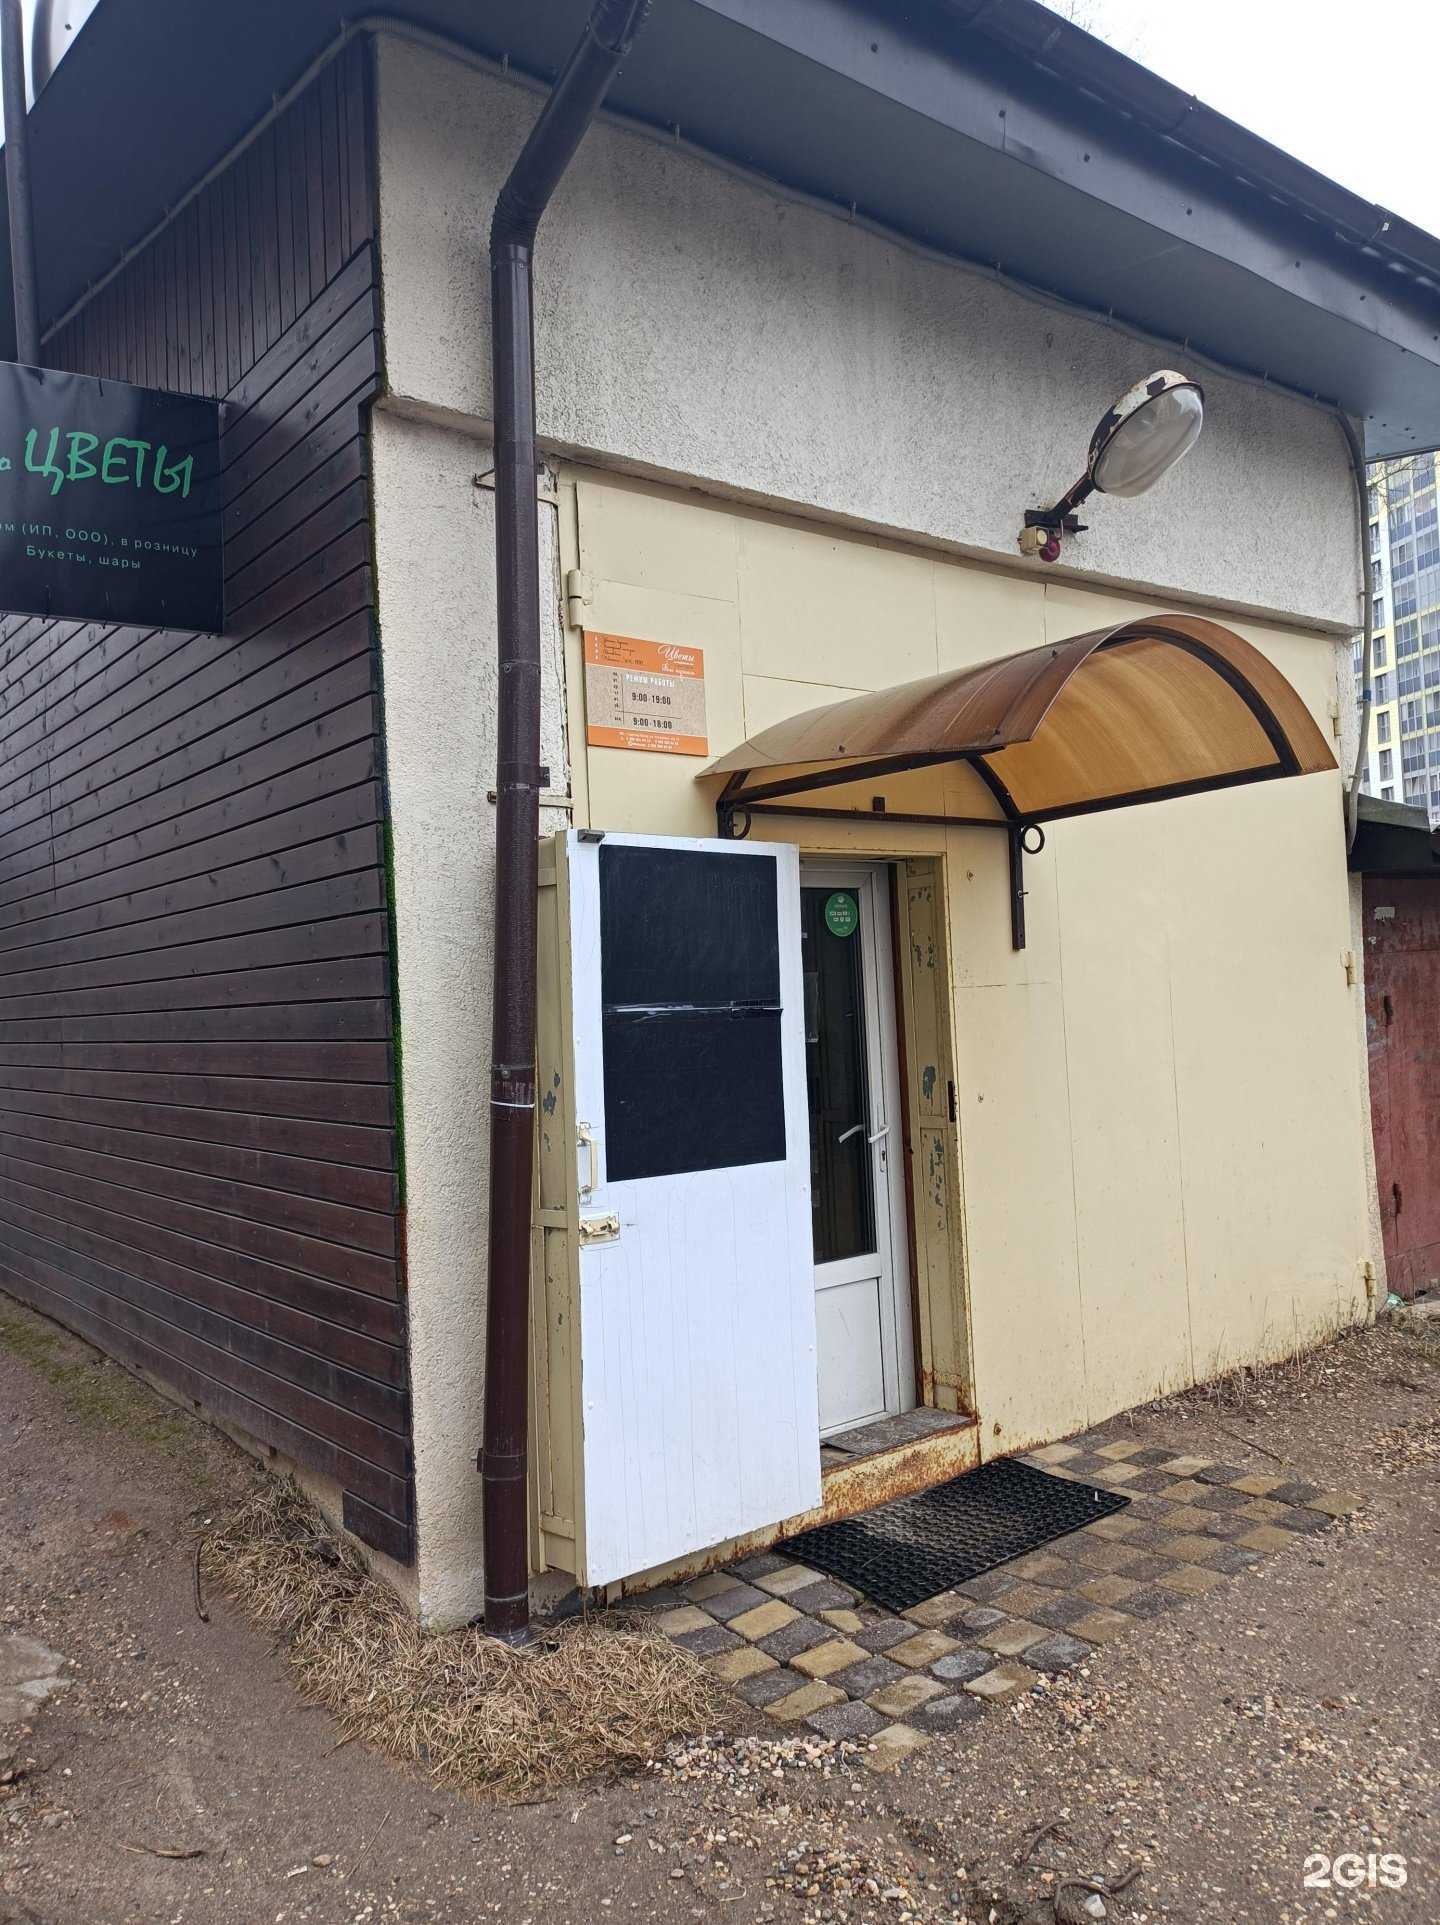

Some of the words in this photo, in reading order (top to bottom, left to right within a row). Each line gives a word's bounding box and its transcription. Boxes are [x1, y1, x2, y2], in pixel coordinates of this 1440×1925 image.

[24, 426, 194, 499] ЦВЕТЫ
[26, 545, 93, 564] Букеты,
[98, 556, 141, 569] шары
[121, 537, 128, 546] в
[134, 540, 198, 557] розницу
[625, 673, 649, 684] РЕЖИМ
[649, 676, 675, 688] РАБОТЫ
